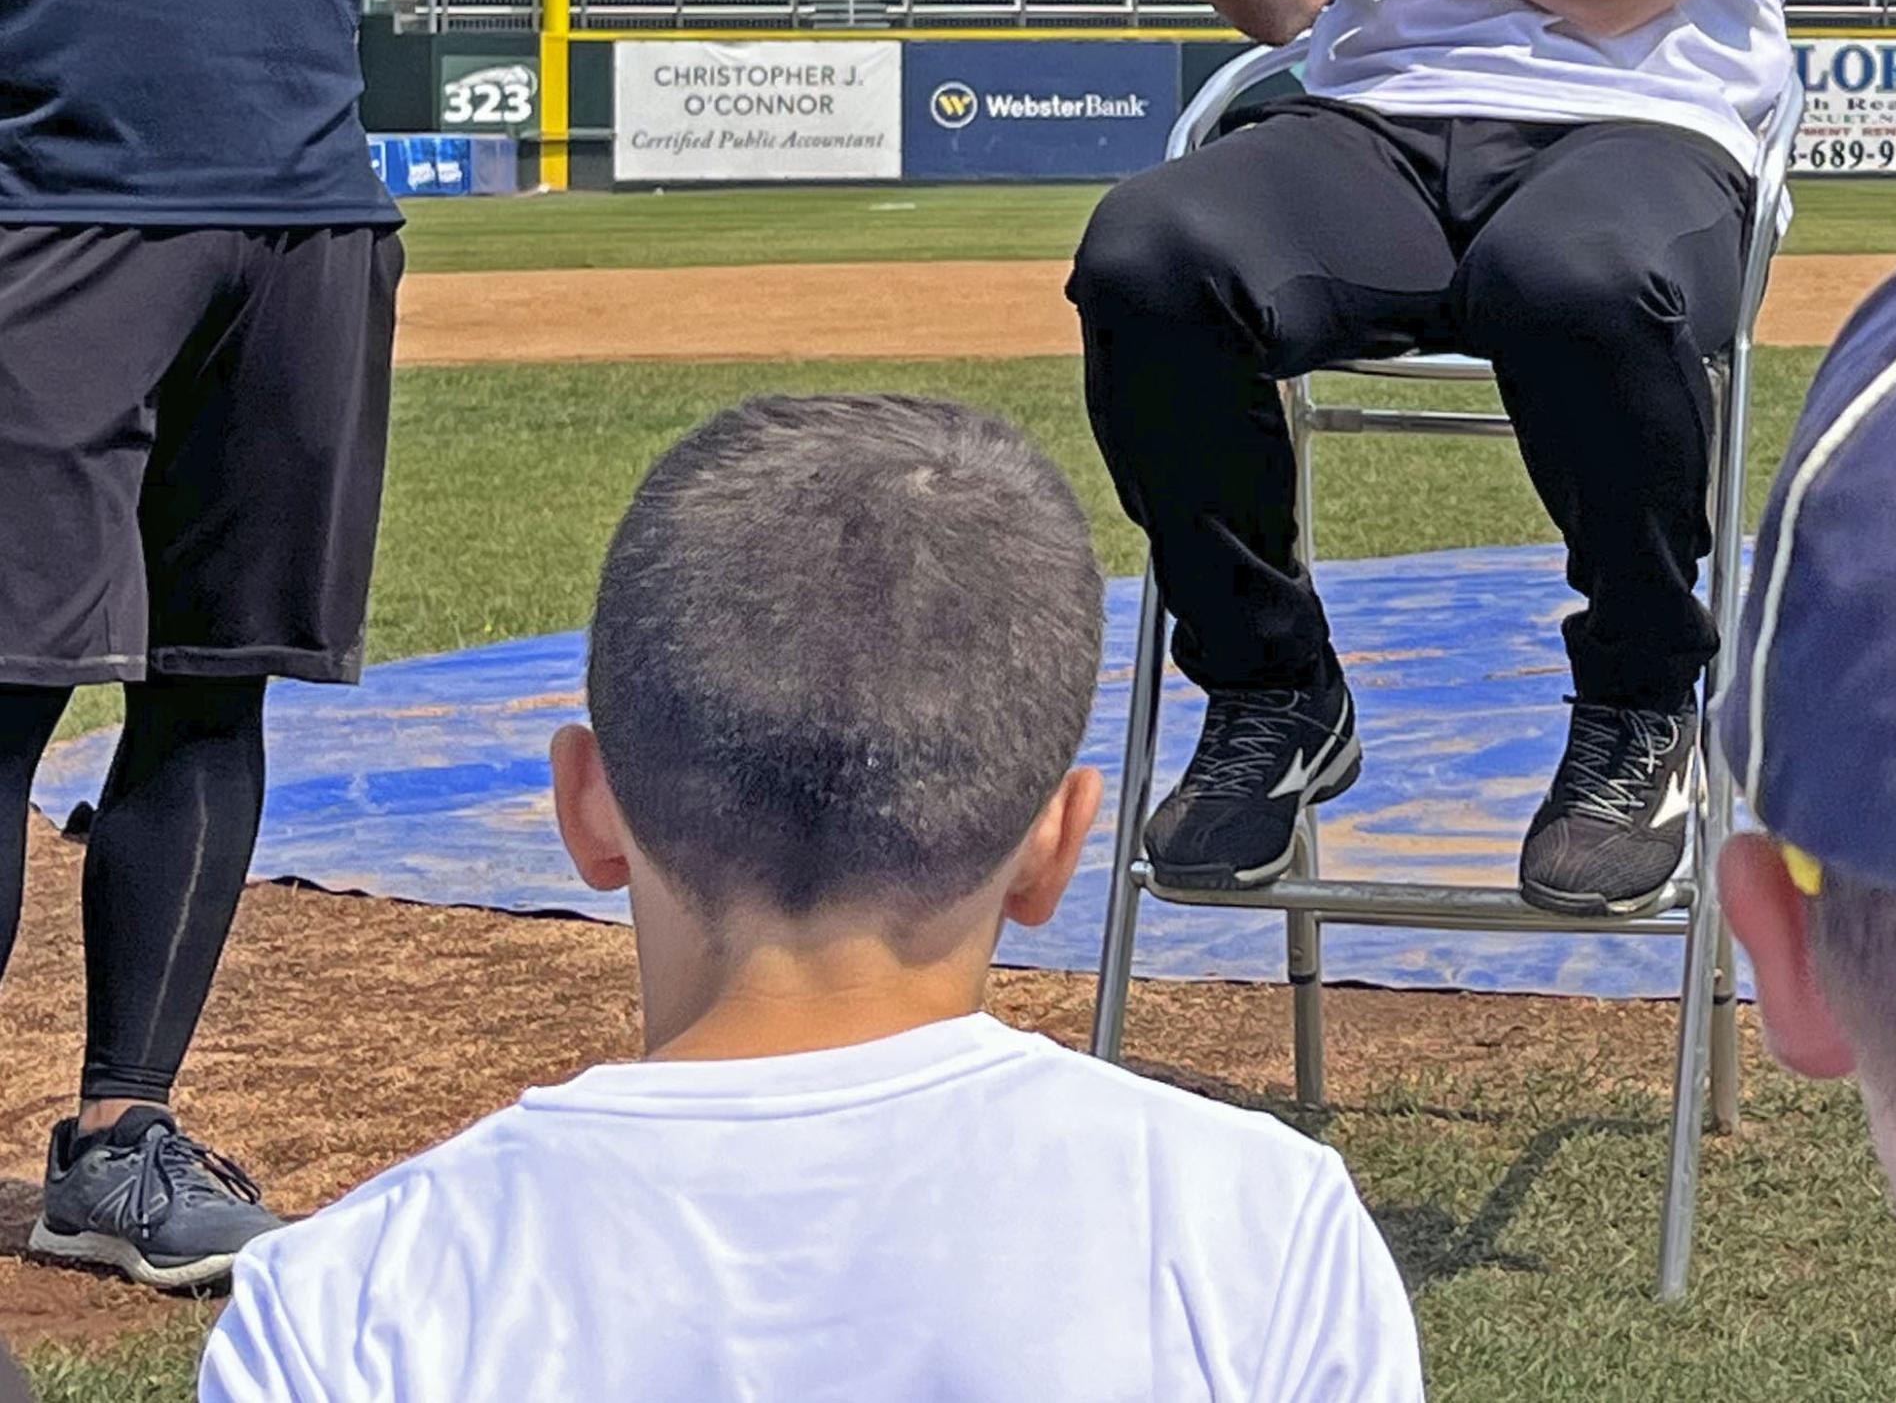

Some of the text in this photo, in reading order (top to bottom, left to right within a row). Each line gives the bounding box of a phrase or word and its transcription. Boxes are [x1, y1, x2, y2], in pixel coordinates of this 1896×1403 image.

[653, 64, 864, 87] CHRISTOPHER J.
[444, 81, 532, 123] 323
[683, 93, 835, 117] O'CONNOR
[631, 129, 886, 155] Certified Public Accountant
